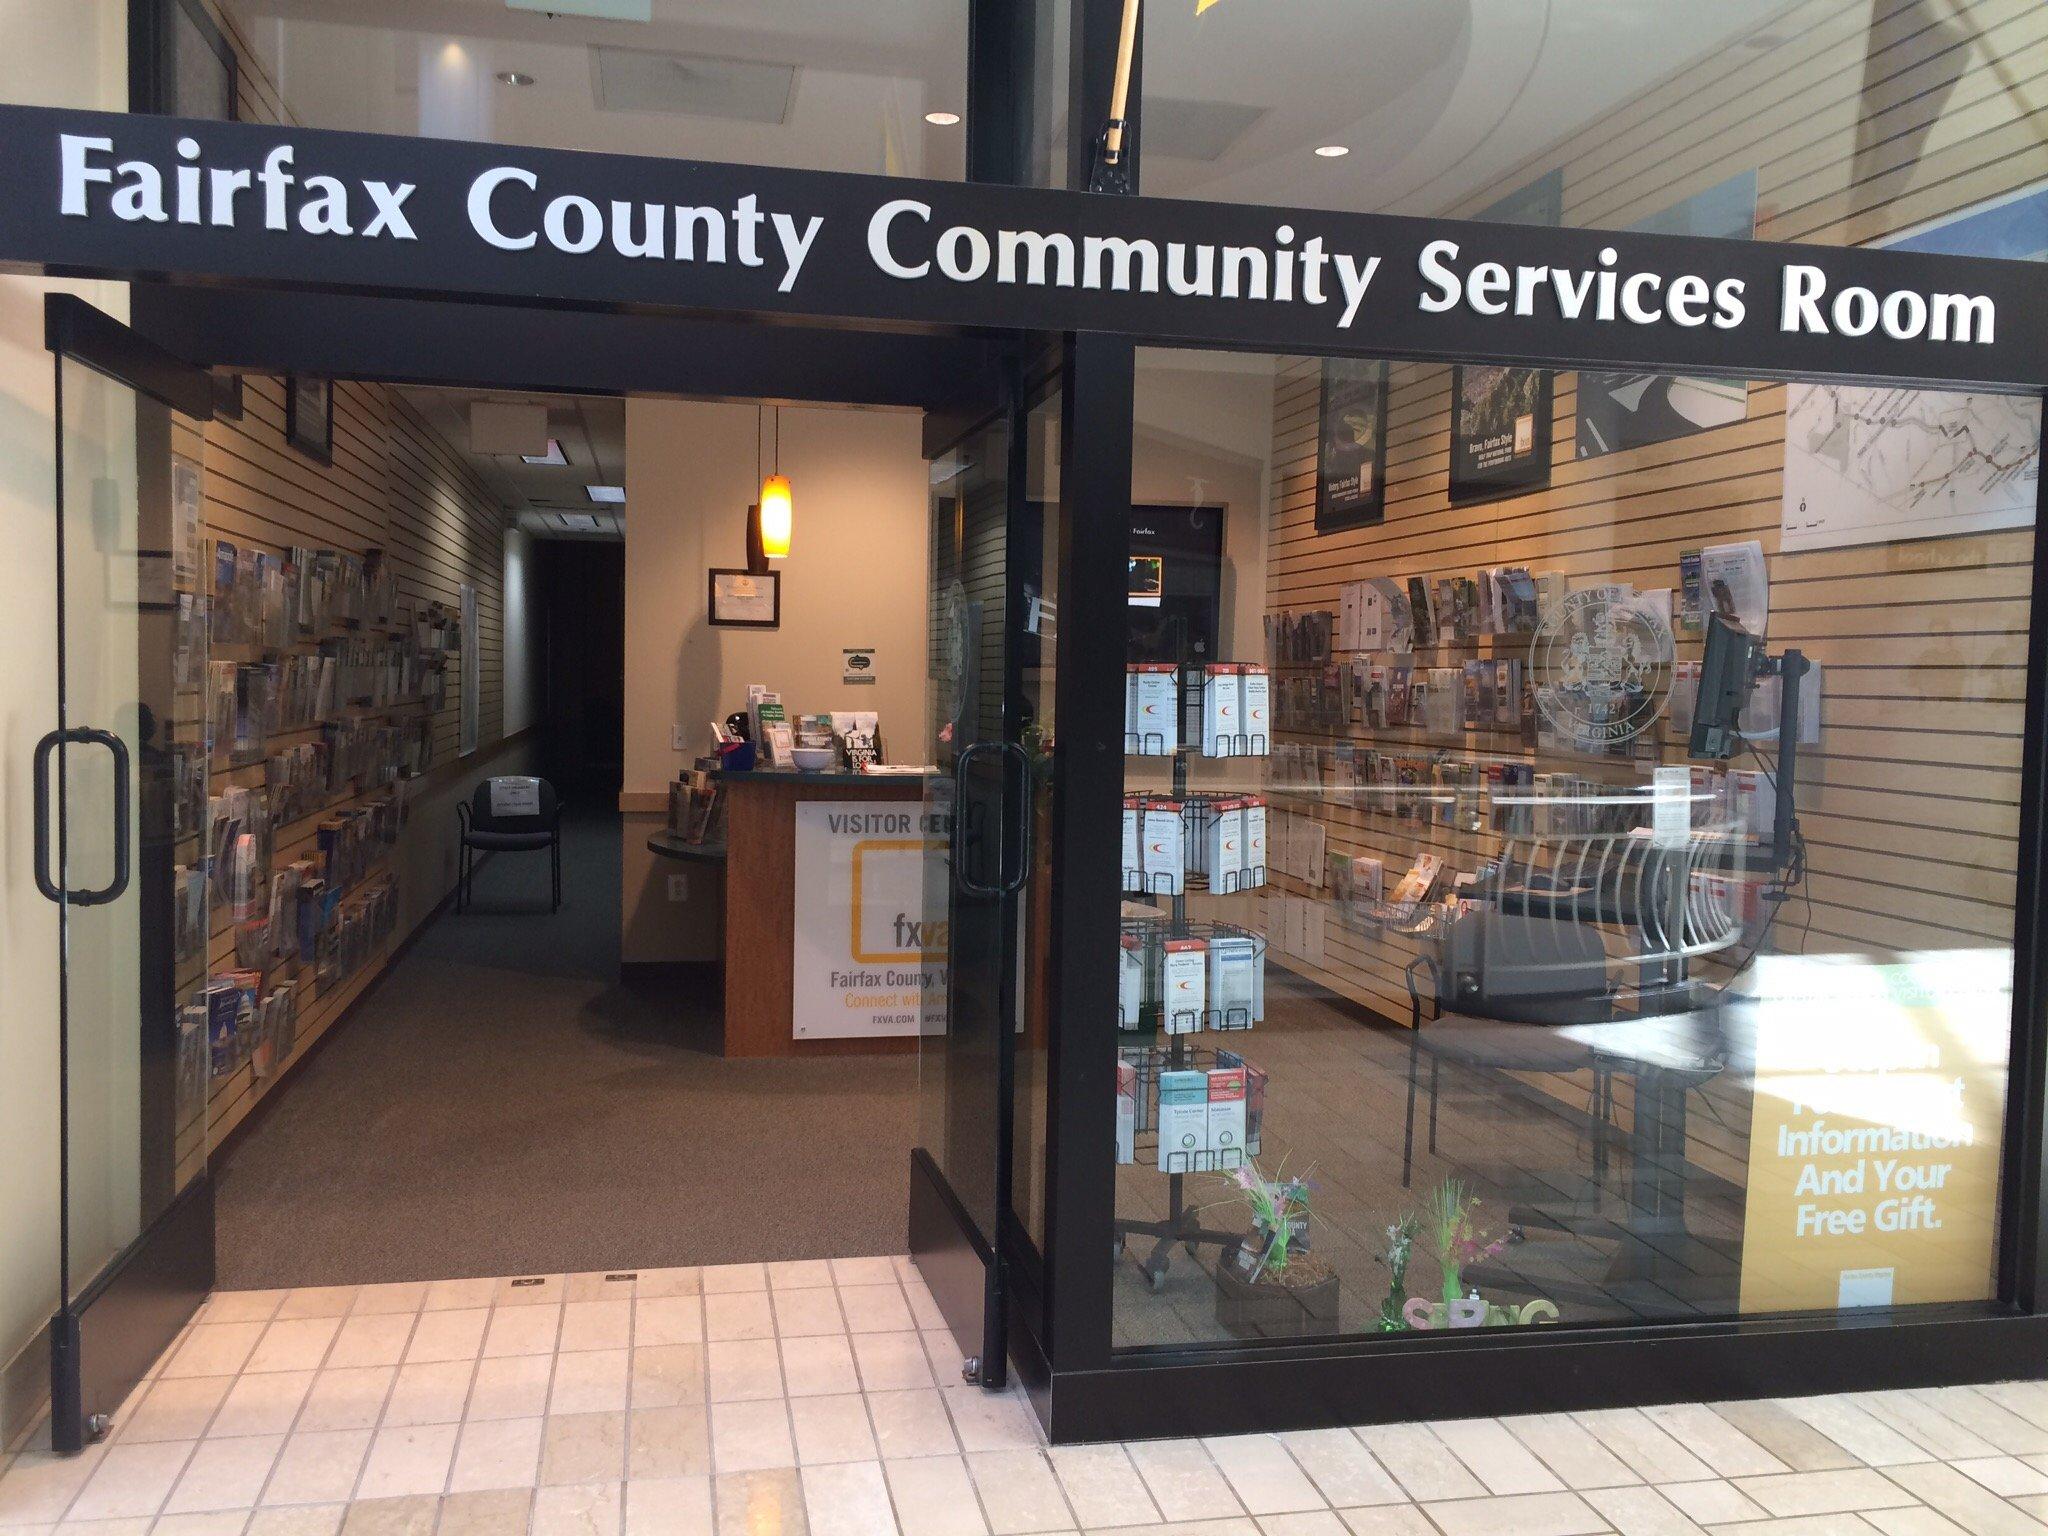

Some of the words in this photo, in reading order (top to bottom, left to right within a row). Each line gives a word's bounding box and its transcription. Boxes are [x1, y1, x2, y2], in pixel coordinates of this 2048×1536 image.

[59, 131, 420, 241] Fairfax
[465, 163, 828, 295] County
[866, 196, 1383, 330] Community
[1417, 237, 1749, 331] Services
[1780, 262, 1998, 347] Room
[1484, 436, 1500, 449] Fairfax
[1500, 433, 1513, 445] Style
[1132, 527, 1156, 536] Fairfax
[1588, 703, 1616, 714] 1742
[828, 814, 911, 834] VISITOR
[830, 970, 882, 988] Fairfax
[845, 992, 898, 1008] Connect
[902, 992, 921, 1008] wit
[872, 1015, 915, 1024] FXVA.COM
[1794, 1159, 1866, 1197] And
[1873, 1158, 1952, 1193] Your
[1796, 1203, 1867, 1237] Free
[1874, 1195, 1942, 1233] Gift.
[1287, 1221, 1308, 1230] OUNTY
